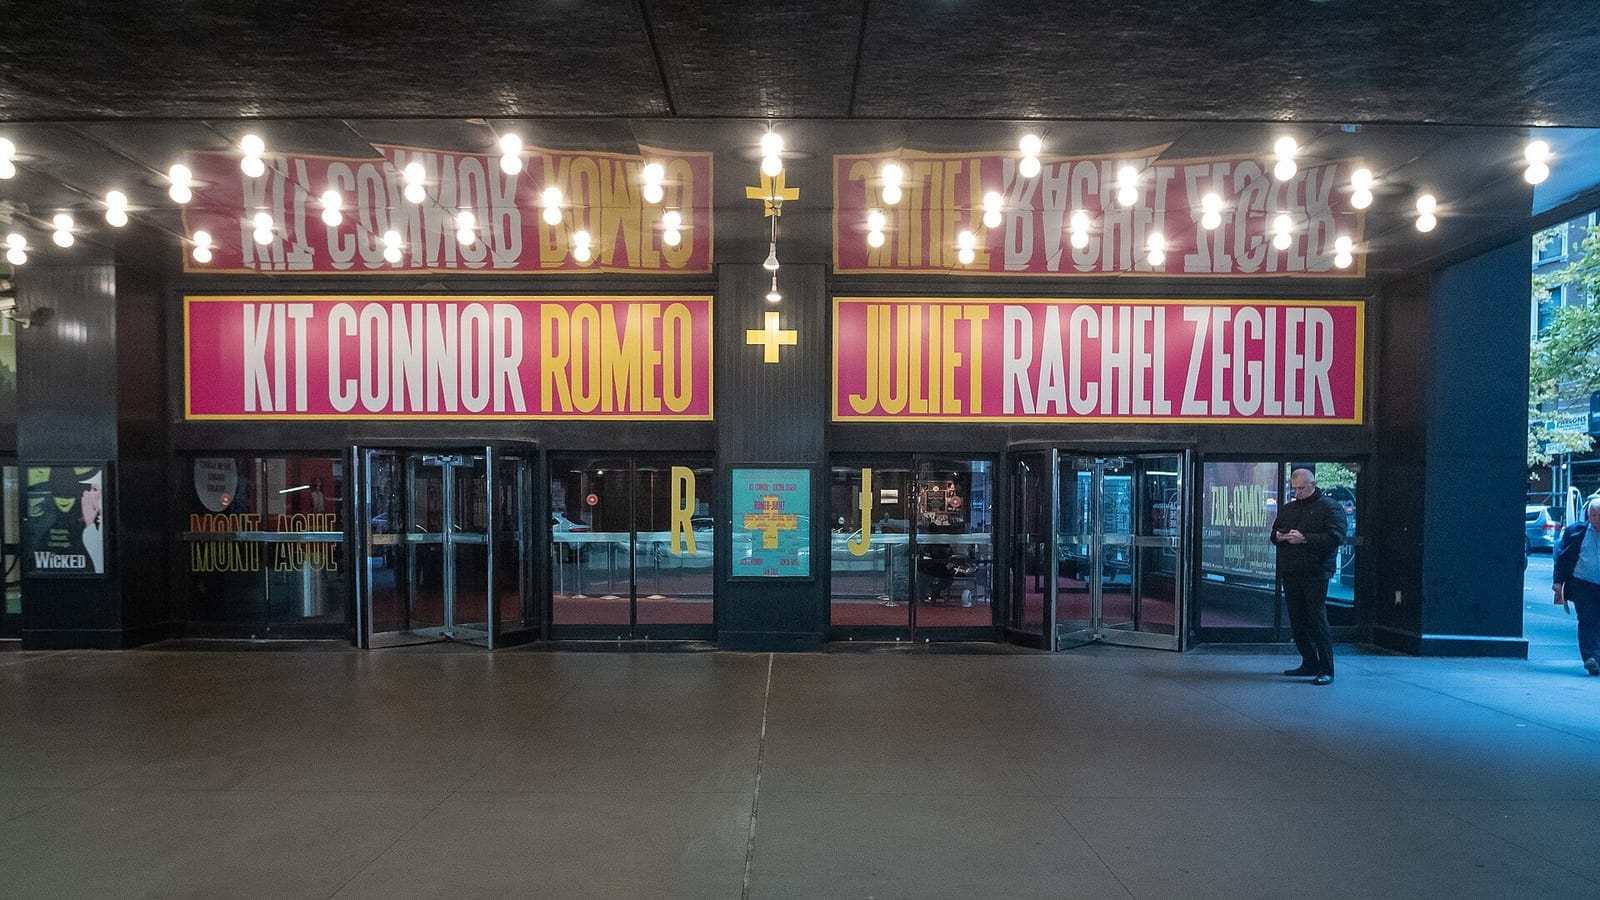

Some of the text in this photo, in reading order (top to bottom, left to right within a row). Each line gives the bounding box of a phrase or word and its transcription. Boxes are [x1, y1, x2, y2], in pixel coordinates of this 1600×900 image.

[242, 302, 693, 414] KIT CONNOR ROMEO
[848, 304, 1336, 417] JULIET RACHEL ZEGLER
[190, 513, 338, 572] MONT AGUE
[671, 466, 698, 555] R
[847, 468, 872, 557] J
